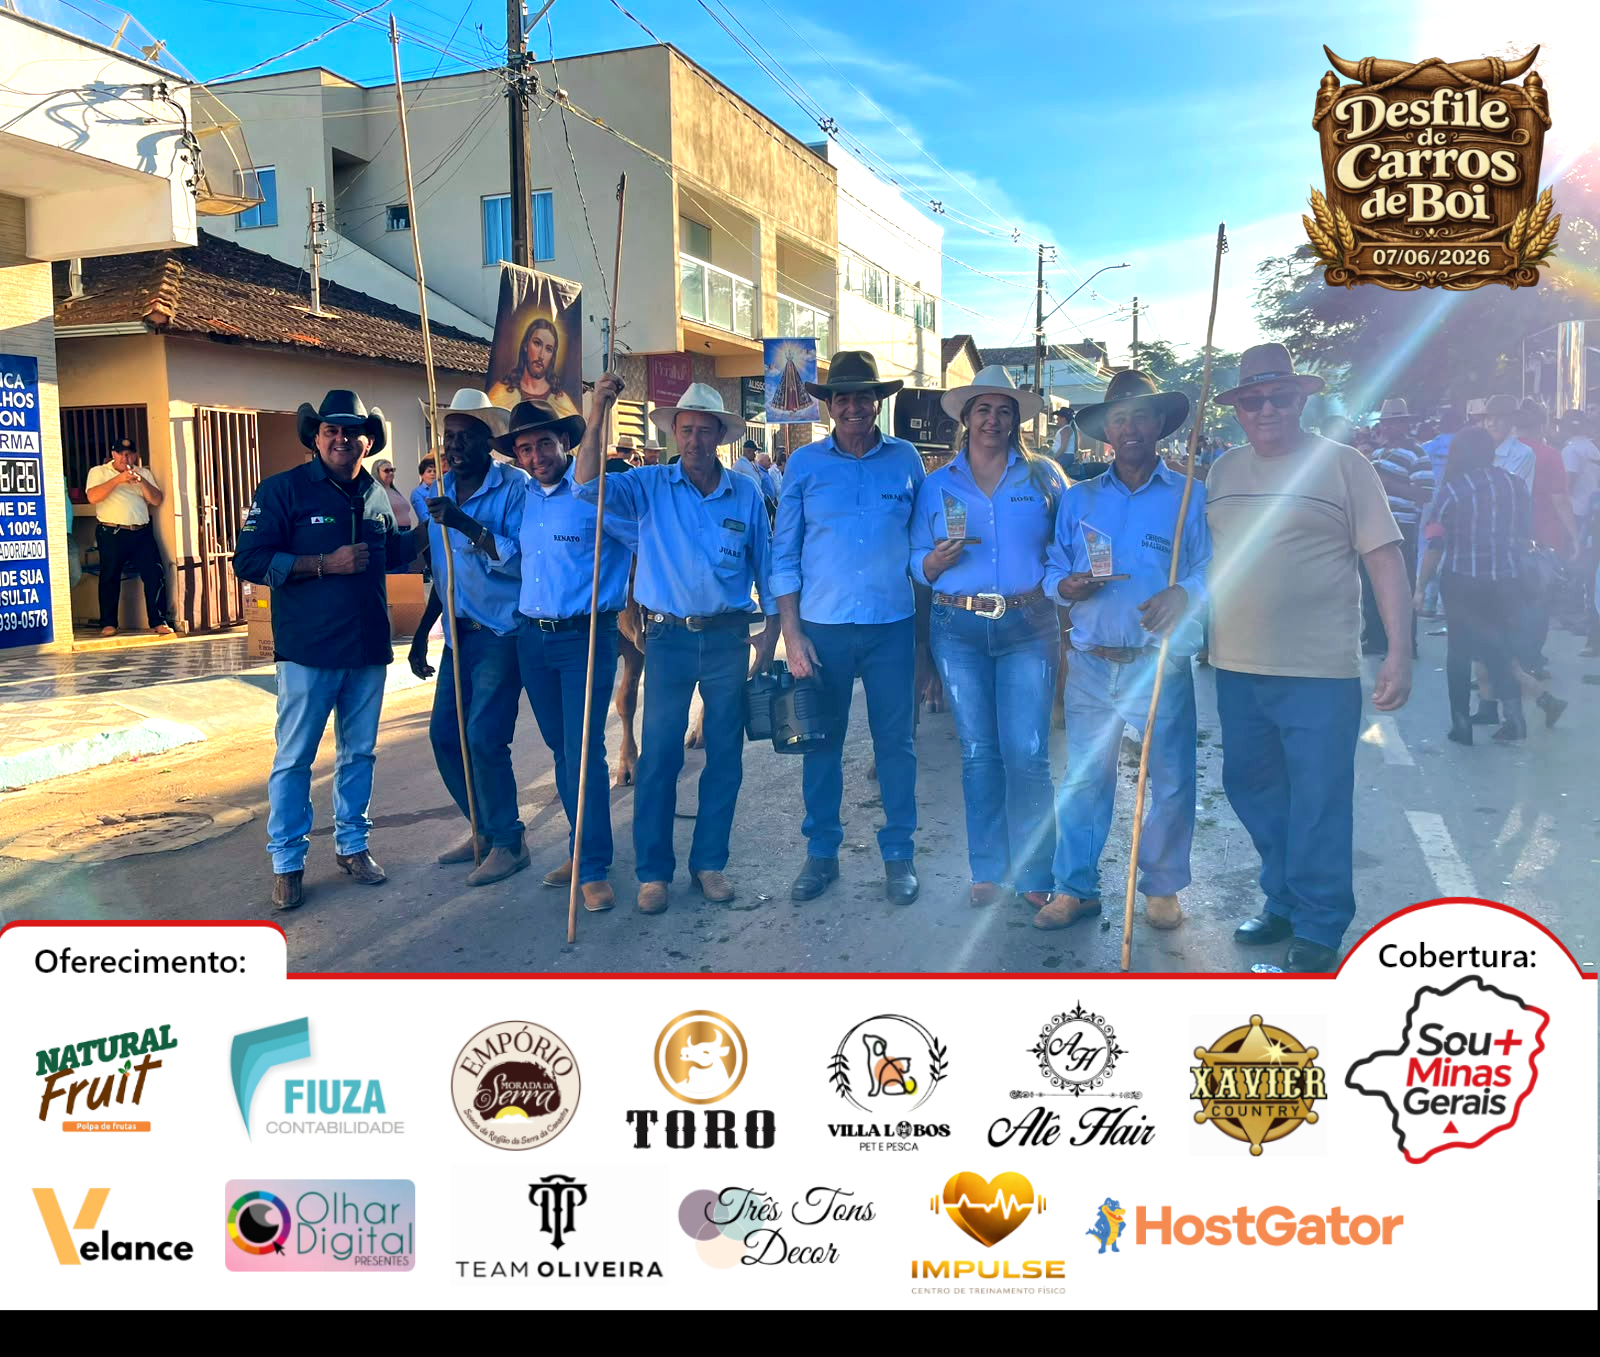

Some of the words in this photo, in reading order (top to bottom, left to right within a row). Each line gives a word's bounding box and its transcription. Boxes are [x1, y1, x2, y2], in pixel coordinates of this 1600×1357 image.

[17, 501, 37, 516] DE
[7, 521, 42, 536] 100%
[20, 568, 44, 586] SUA
